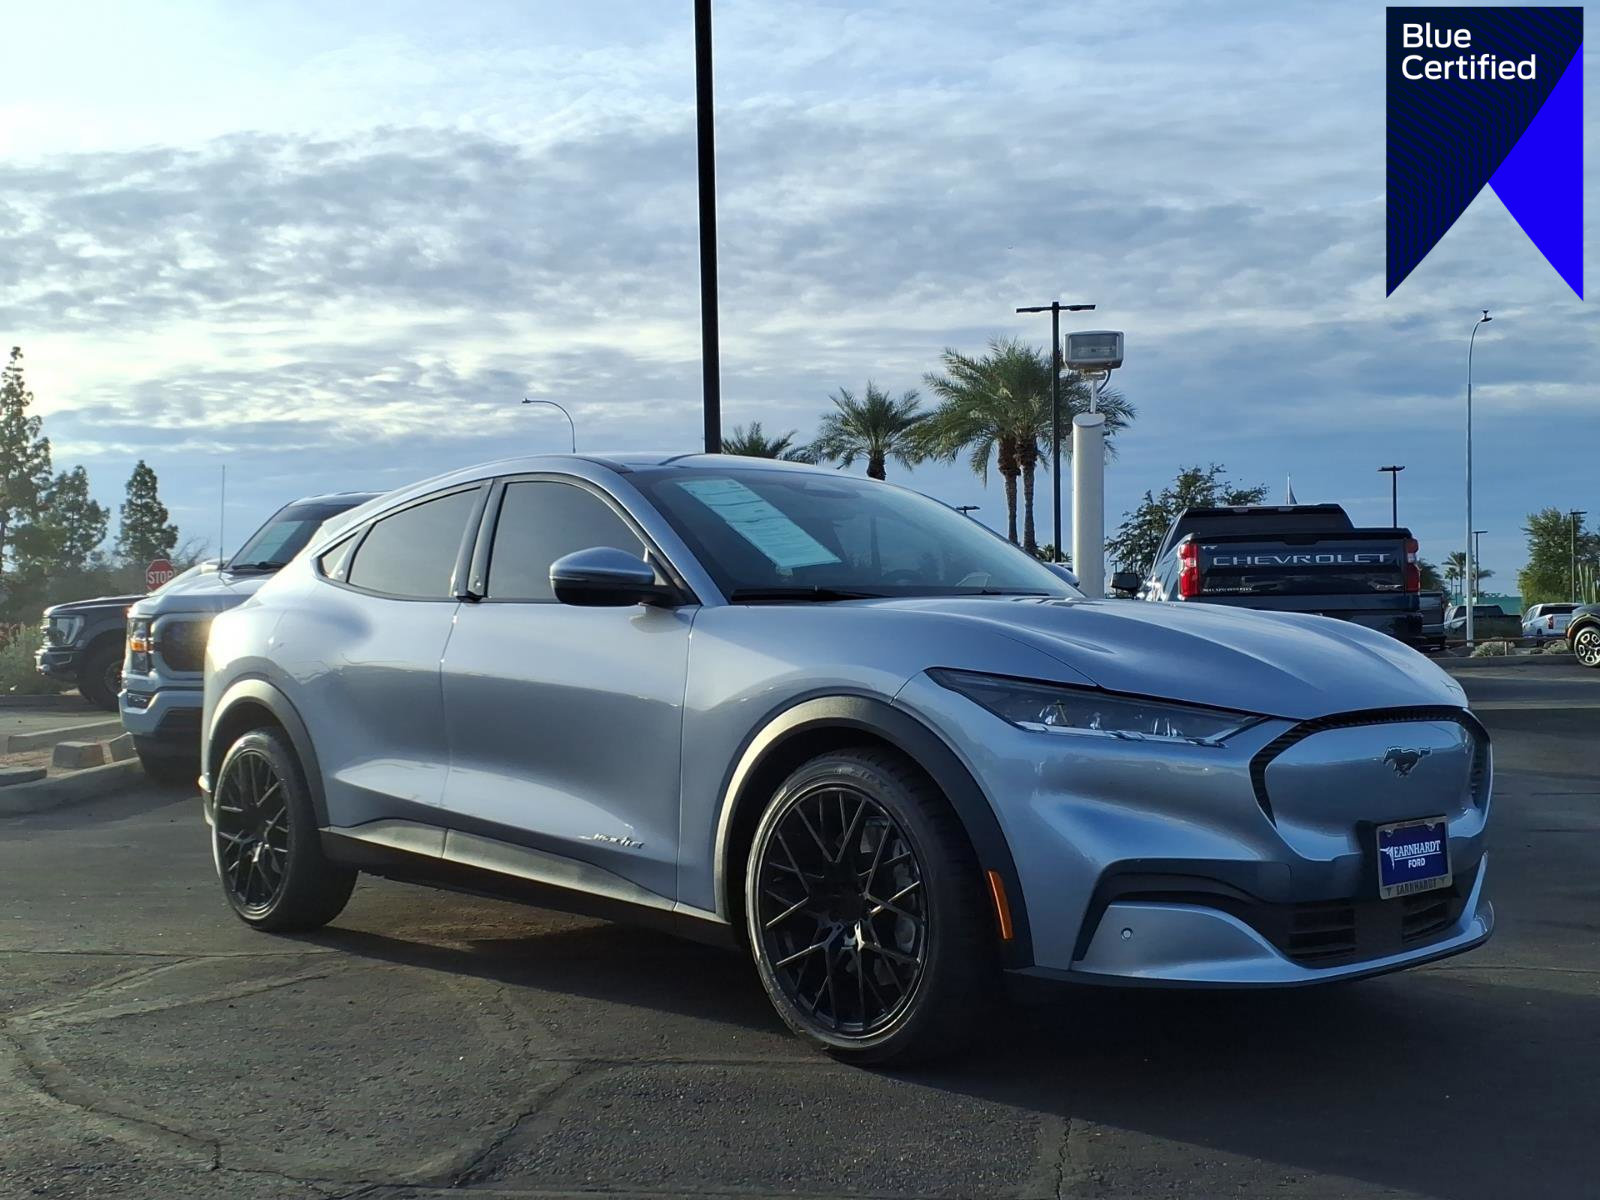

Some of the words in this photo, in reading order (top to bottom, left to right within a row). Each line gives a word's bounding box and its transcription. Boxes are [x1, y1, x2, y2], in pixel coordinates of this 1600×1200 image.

[1213, 553, 1391, 566] CHEVROLET
[148, 570, 174, 584] STOP
[1394, 840, 1441, 858] EARNHARDT
[1408, 858, 1426, 868] FORD
